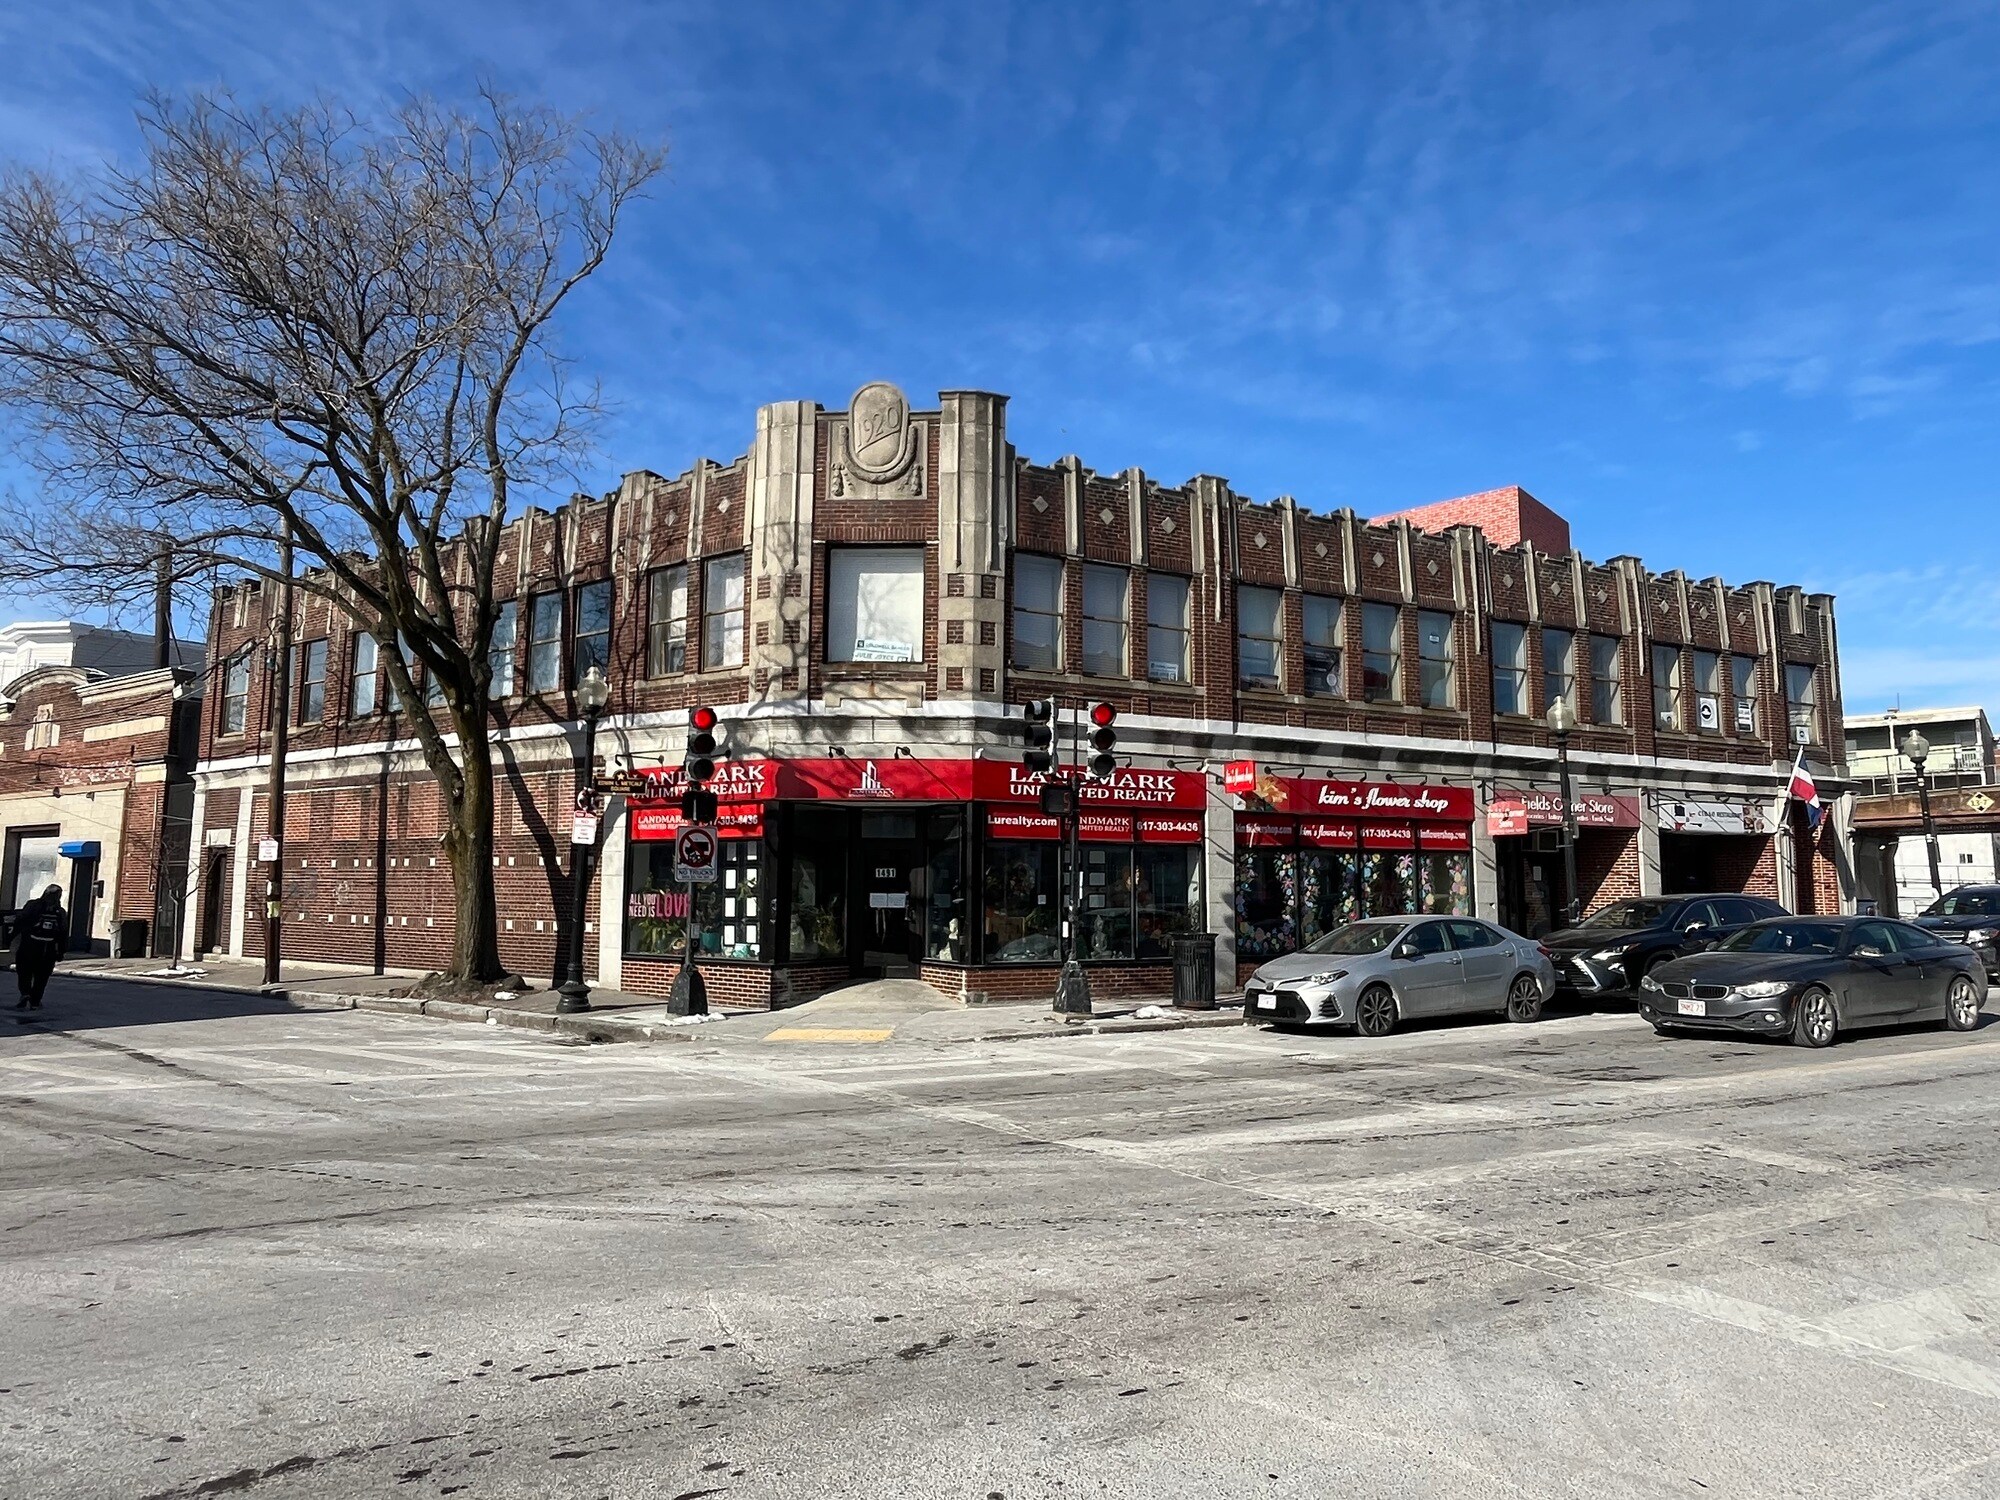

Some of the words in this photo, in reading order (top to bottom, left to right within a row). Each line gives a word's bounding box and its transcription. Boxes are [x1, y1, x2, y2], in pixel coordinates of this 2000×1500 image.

[857, 406, 899, 447] 1920
[633, 765, 765, 786] ANDARK
[632, 784, 706, 799] NLIMIT
[710, 782, 764, 795] REALTY
[1010, 785, 1109, 799] UNTED
[1114, 789, 1175, 802] REALTY
[1318, 785, 1362, 805] kim's
[1361, 787, 1410, 809] flower
[1413, 789, 1448, 813] shop
[1553, 797, 1586, 812] Cner
[1589, 800, 1614, 814] Store
[988, 815, 1058, 827] Lurealty.com
[1065, 816, 1130, 826] LNDMARK
[1137, 821, 1198, 832] 617-303-4436
[630, 894, 641, 904] ALL
[643, 894, 656, 905] YOU
[629, 906, 646, 917] NEED
[648, 906, 655, 917] IS
